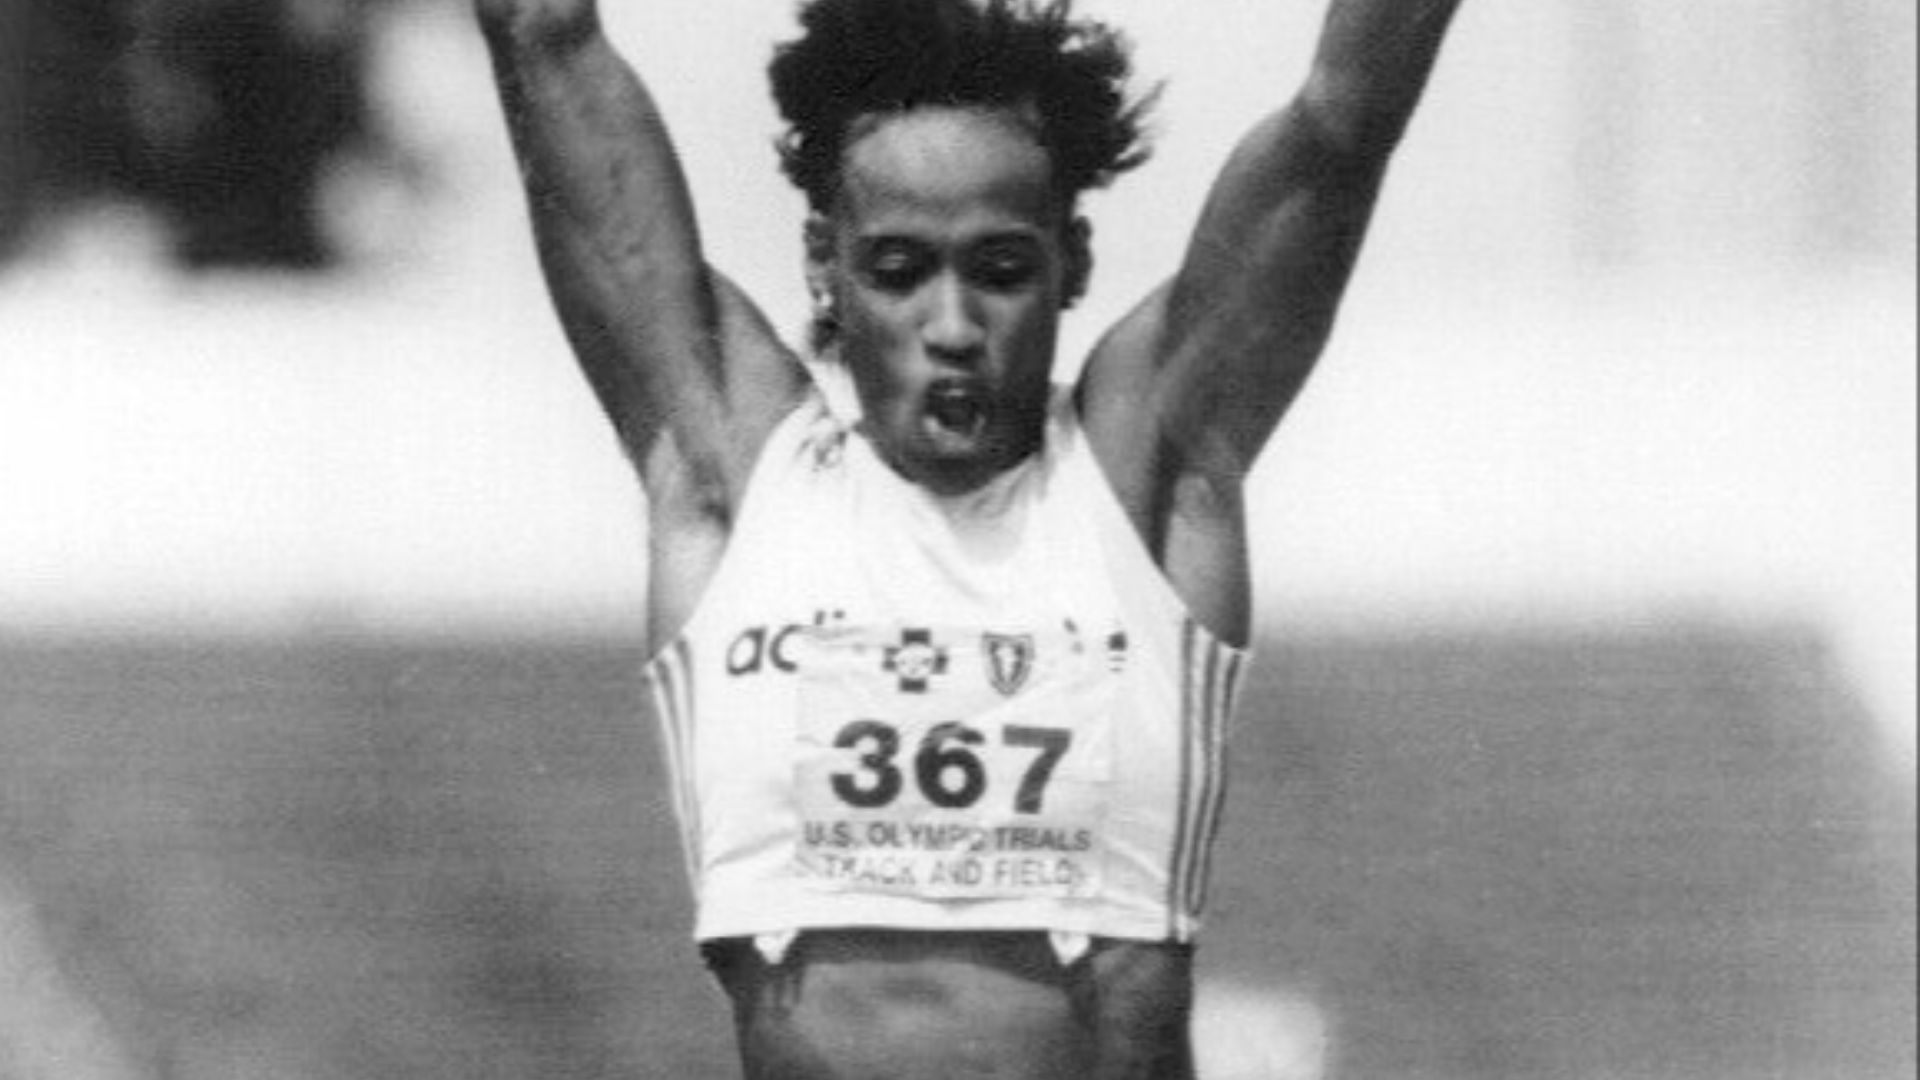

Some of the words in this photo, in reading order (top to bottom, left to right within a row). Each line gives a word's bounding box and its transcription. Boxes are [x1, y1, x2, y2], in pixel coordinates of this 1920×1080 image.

[830, 720, 1072, 814] 367
[868, 822, 986, 851] OLYMPC
[995, 827, 1091, 851] TRIALS
[995, 859, 1074, 886] FIELD
